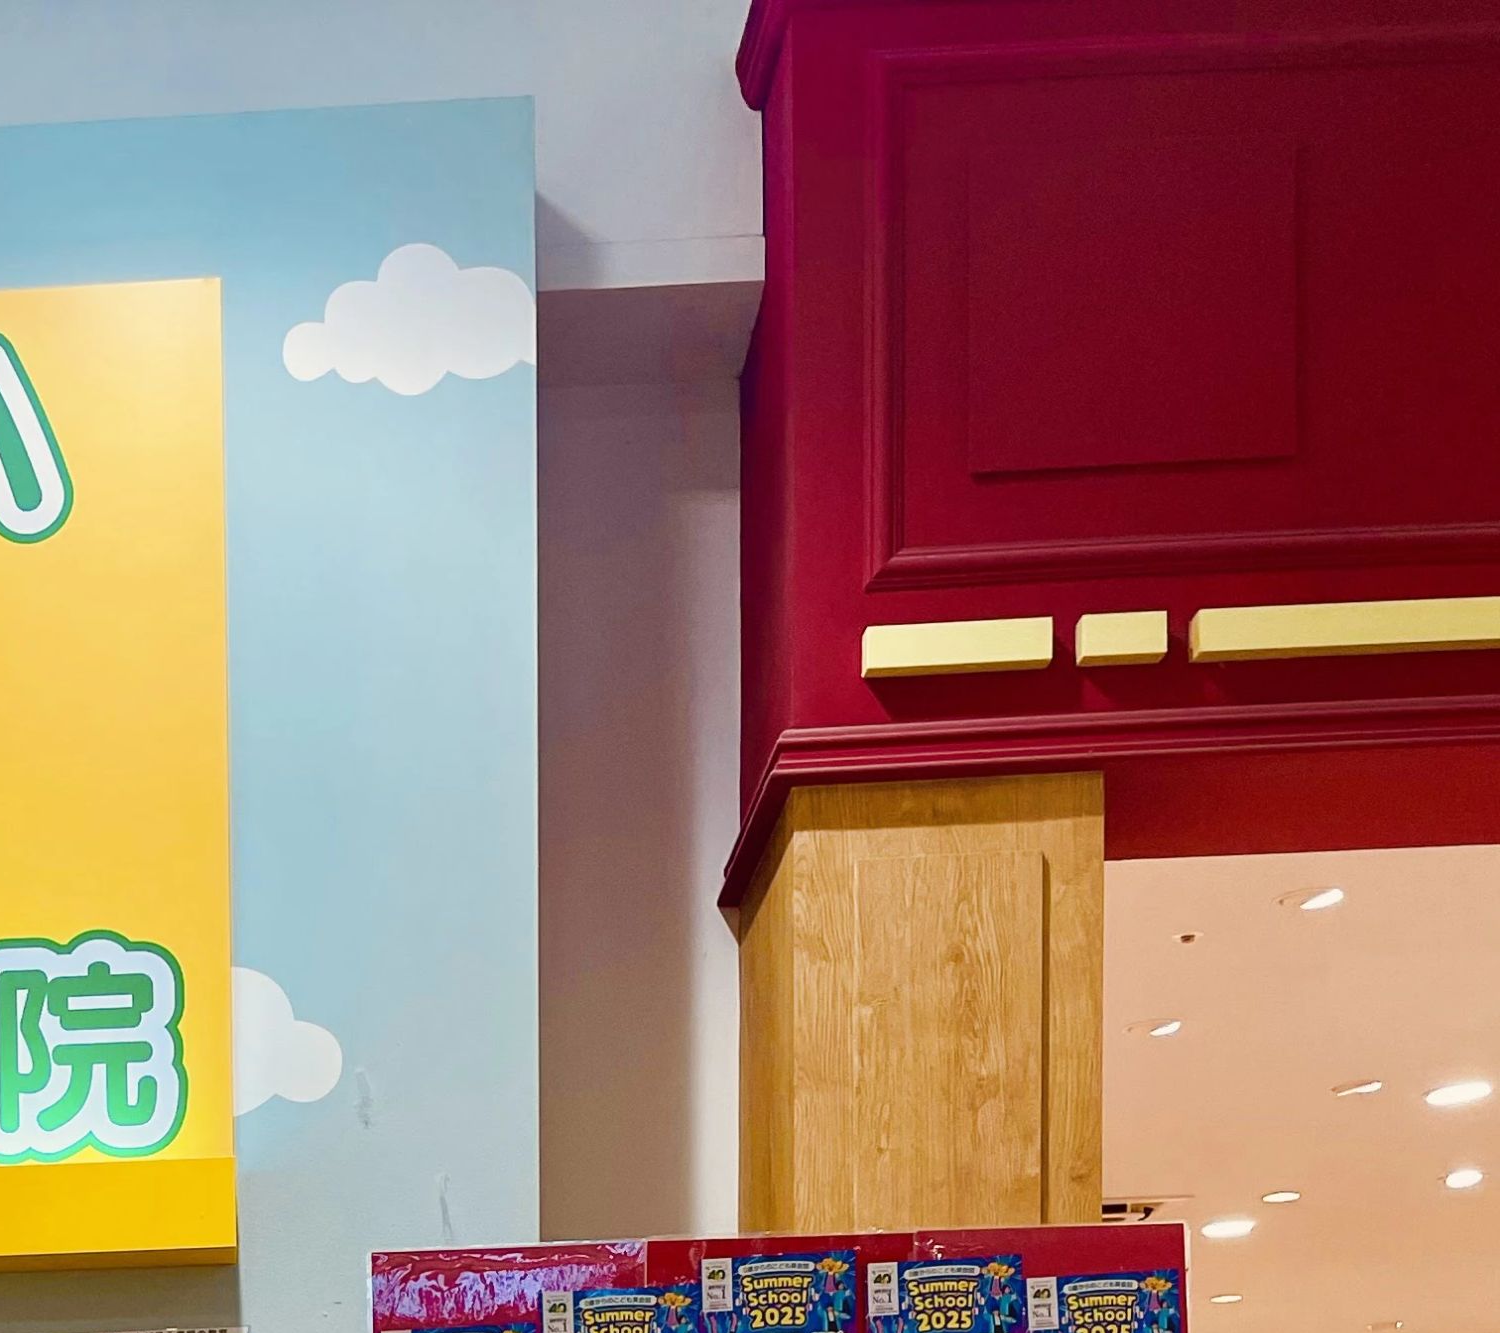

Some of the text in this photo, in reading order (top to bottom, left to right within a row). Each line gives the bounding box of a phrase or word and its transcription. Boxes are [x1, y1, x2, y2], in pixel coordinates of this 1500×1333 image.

[741, 1276, 811, 1292] Summer
[907, 1280, 977, 1295] Summer
[747, 1290, 807, 1306] School
[914, 1295, 974, 1310] School
[1068, 1294, 1136, 1309] Summer
[583, 1310, 654, 1325] Summer
[750, 1307, 806, 1328] 2025
[916, 1311, 972, 1331] 2025
[1074, 1309, 1132, 1324] School
